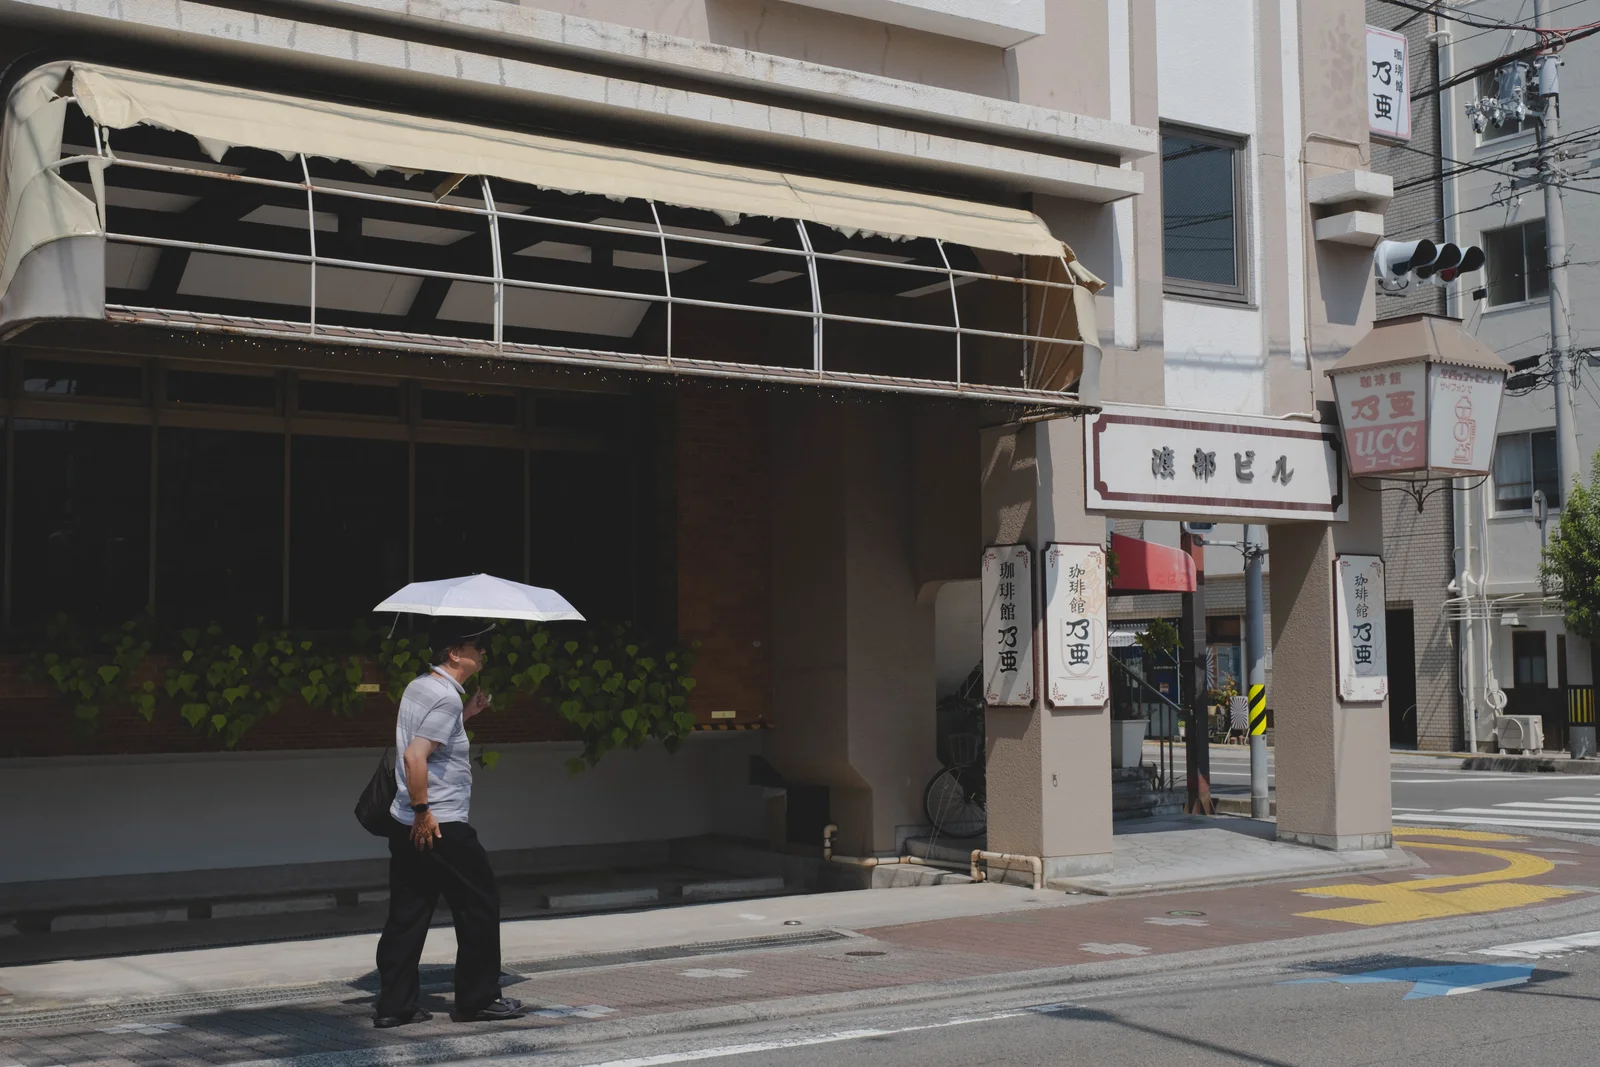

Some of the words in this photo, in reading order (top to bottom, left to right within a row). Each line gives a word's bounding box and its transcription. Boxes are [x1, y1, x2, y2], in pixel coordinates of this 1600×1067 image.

[1393, 48, 1404, 93] 珈琲館
[1371, 60, 1393, 121] 乃亜
[1359, 372, 1402, 389] 珈琲館
[1350, 390, 1416, 421] 乃亜
[1151, 445, 1295, 487] 渡部ビル
[1364, 454, 1416, 468] コーヒー
